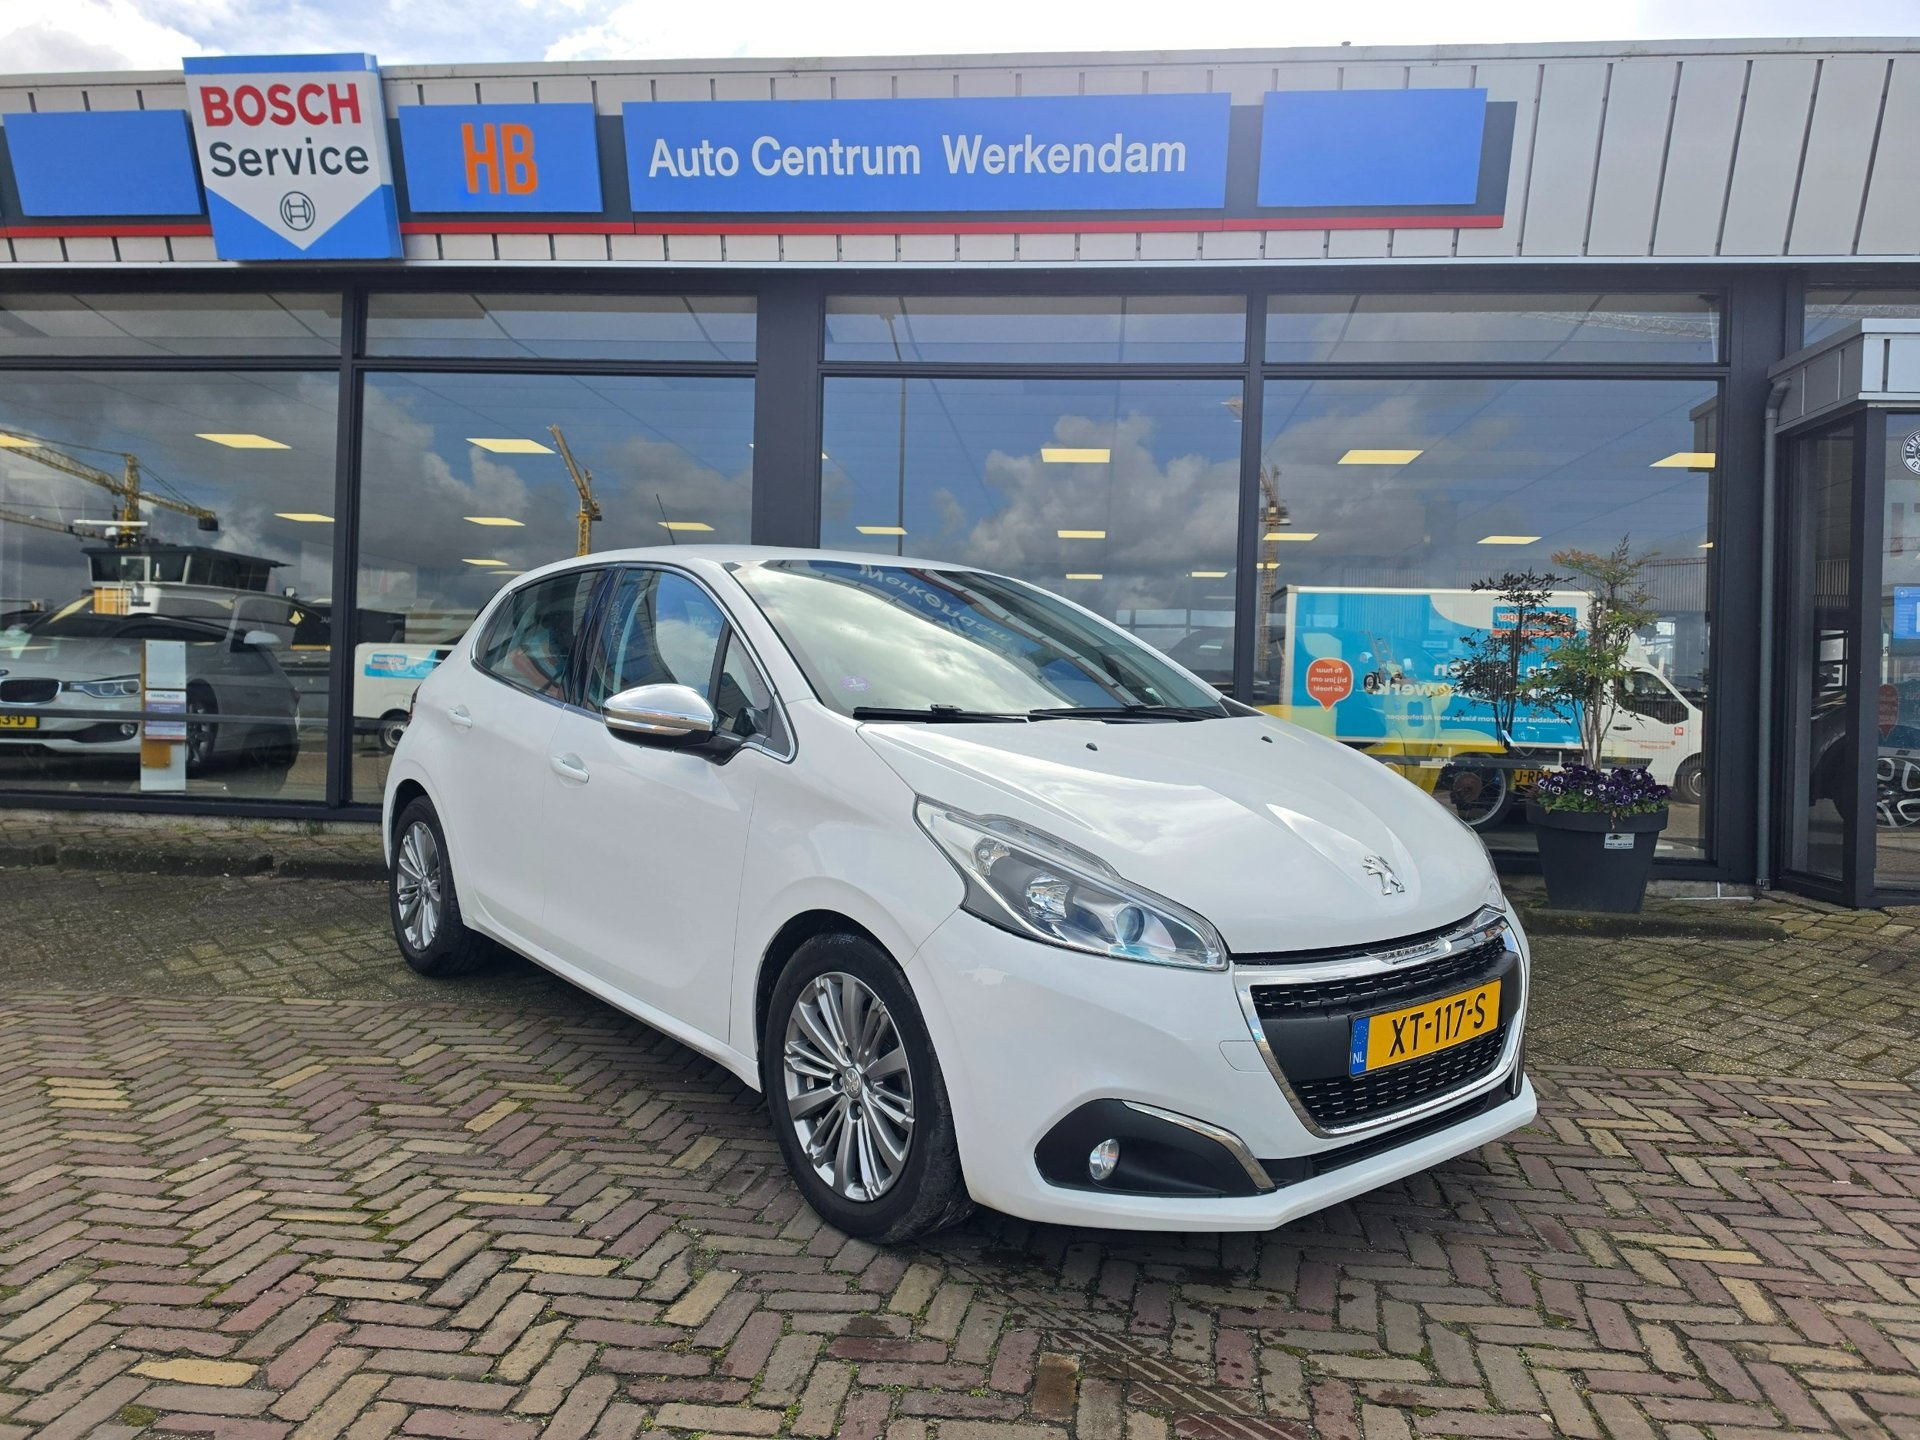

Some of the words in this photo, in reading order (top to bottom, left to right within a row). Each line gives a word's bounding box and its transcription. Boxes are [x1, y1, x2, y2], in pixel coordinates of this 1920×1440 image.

[200, 83, 362, 127] BOSCH
[209, 137, 370, 178] Service
[461, 122, 539, 195] HB
[648, 137, 739, 179] Auto
[751, 135, 921, 177] Centrum
[942, 133, 1187, 175] Werkendam
[1388, 992, 1487, 1058] XT-117-S
[1352, 1050, 1365, 1065] NL
